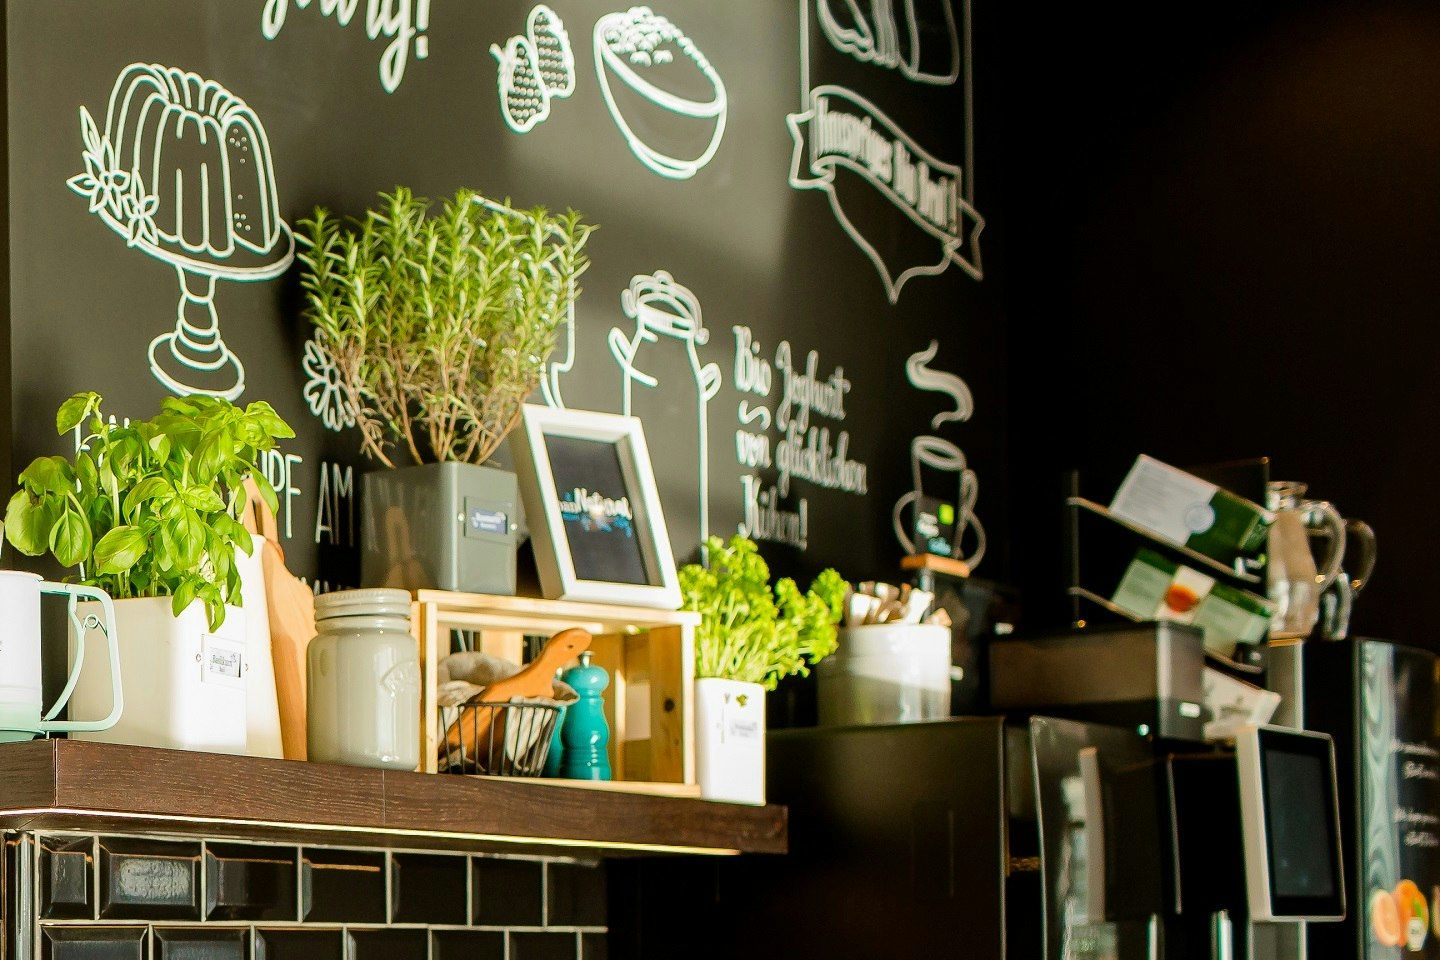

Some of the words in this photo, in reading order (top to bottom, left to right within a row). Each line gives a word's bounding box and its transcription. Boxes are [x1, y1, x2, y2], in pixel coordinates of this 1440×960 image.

[732, 324, 772, 397] Bio
[735, 429, 772, 468] von
[314, 461, 355, 547] AM
